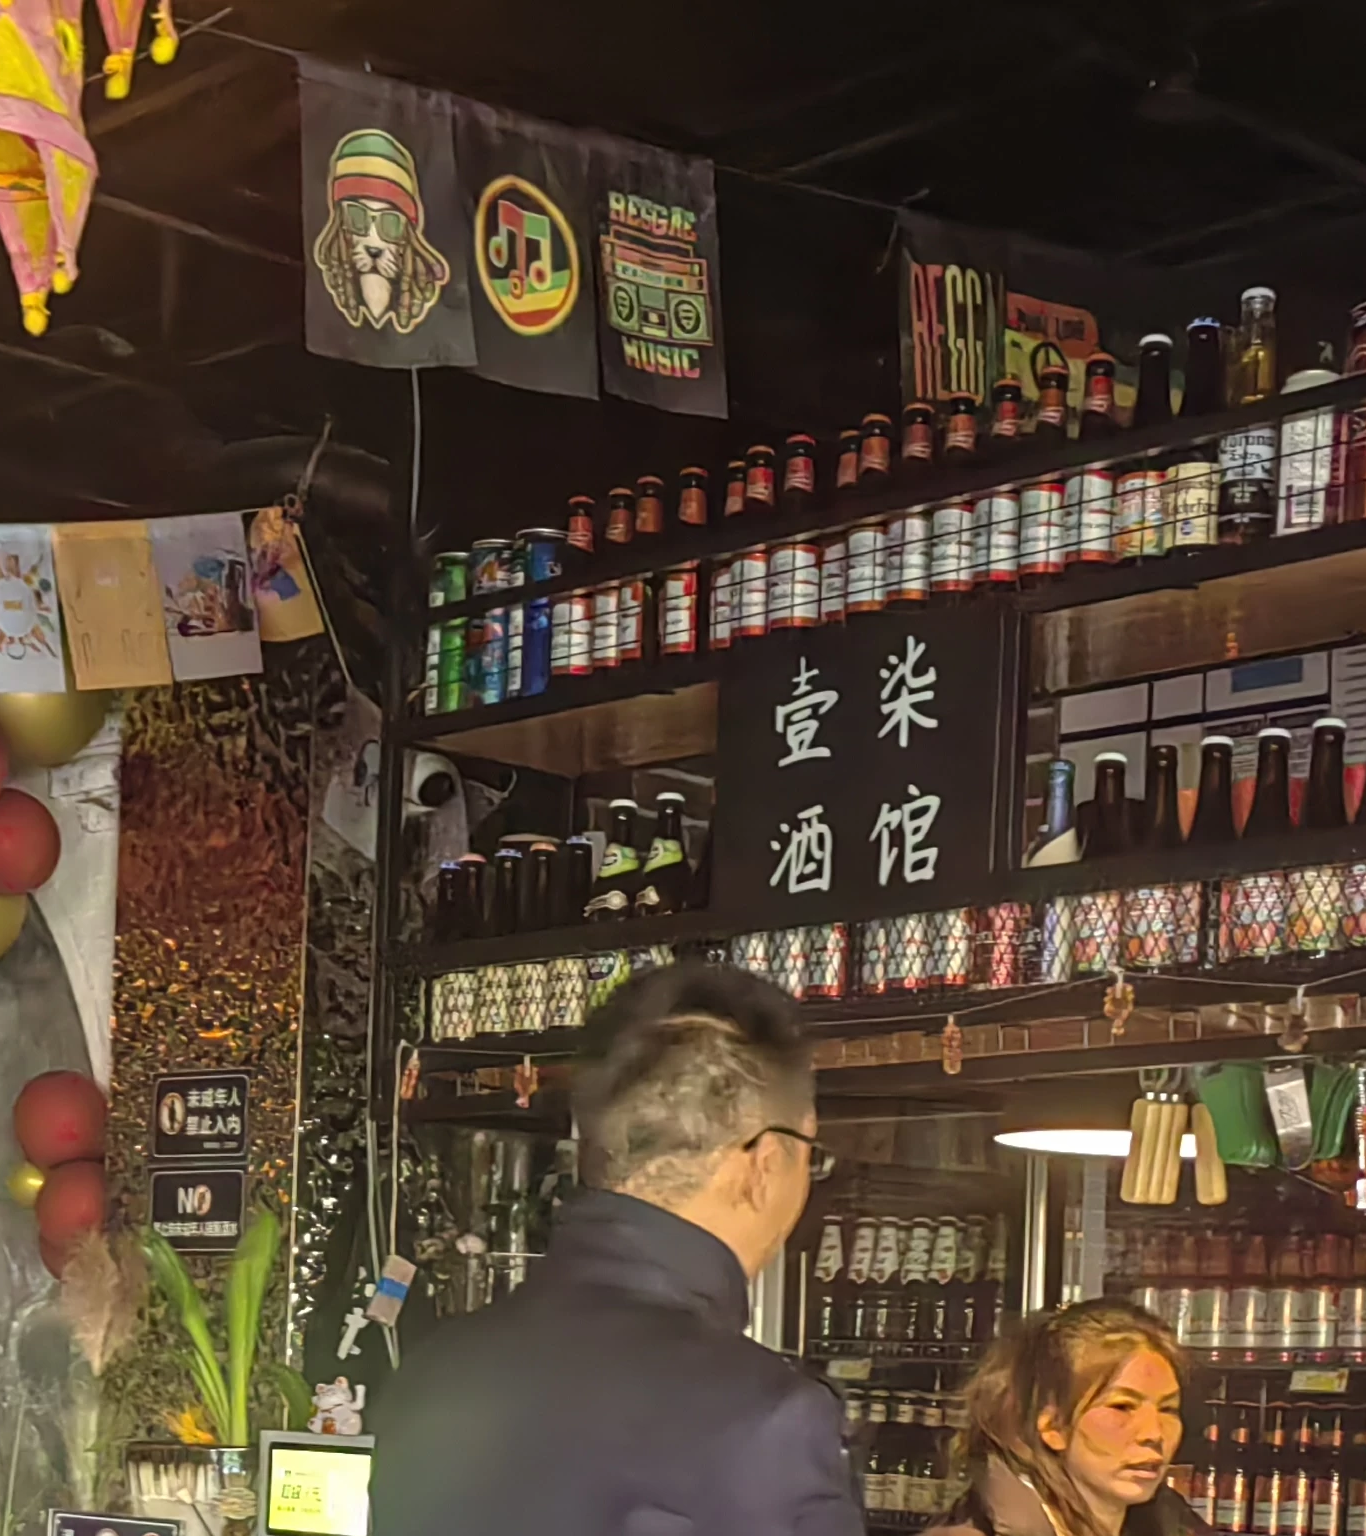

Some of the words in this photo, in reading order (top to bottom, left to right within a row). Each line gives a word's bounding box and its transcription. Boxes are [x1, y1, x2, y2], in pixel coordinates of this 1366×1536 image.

[621, 336, 701, 379] MUSIC
[775, 635, 938, 768] 壹柒
[769, 784, 941, 893] 酒馆
